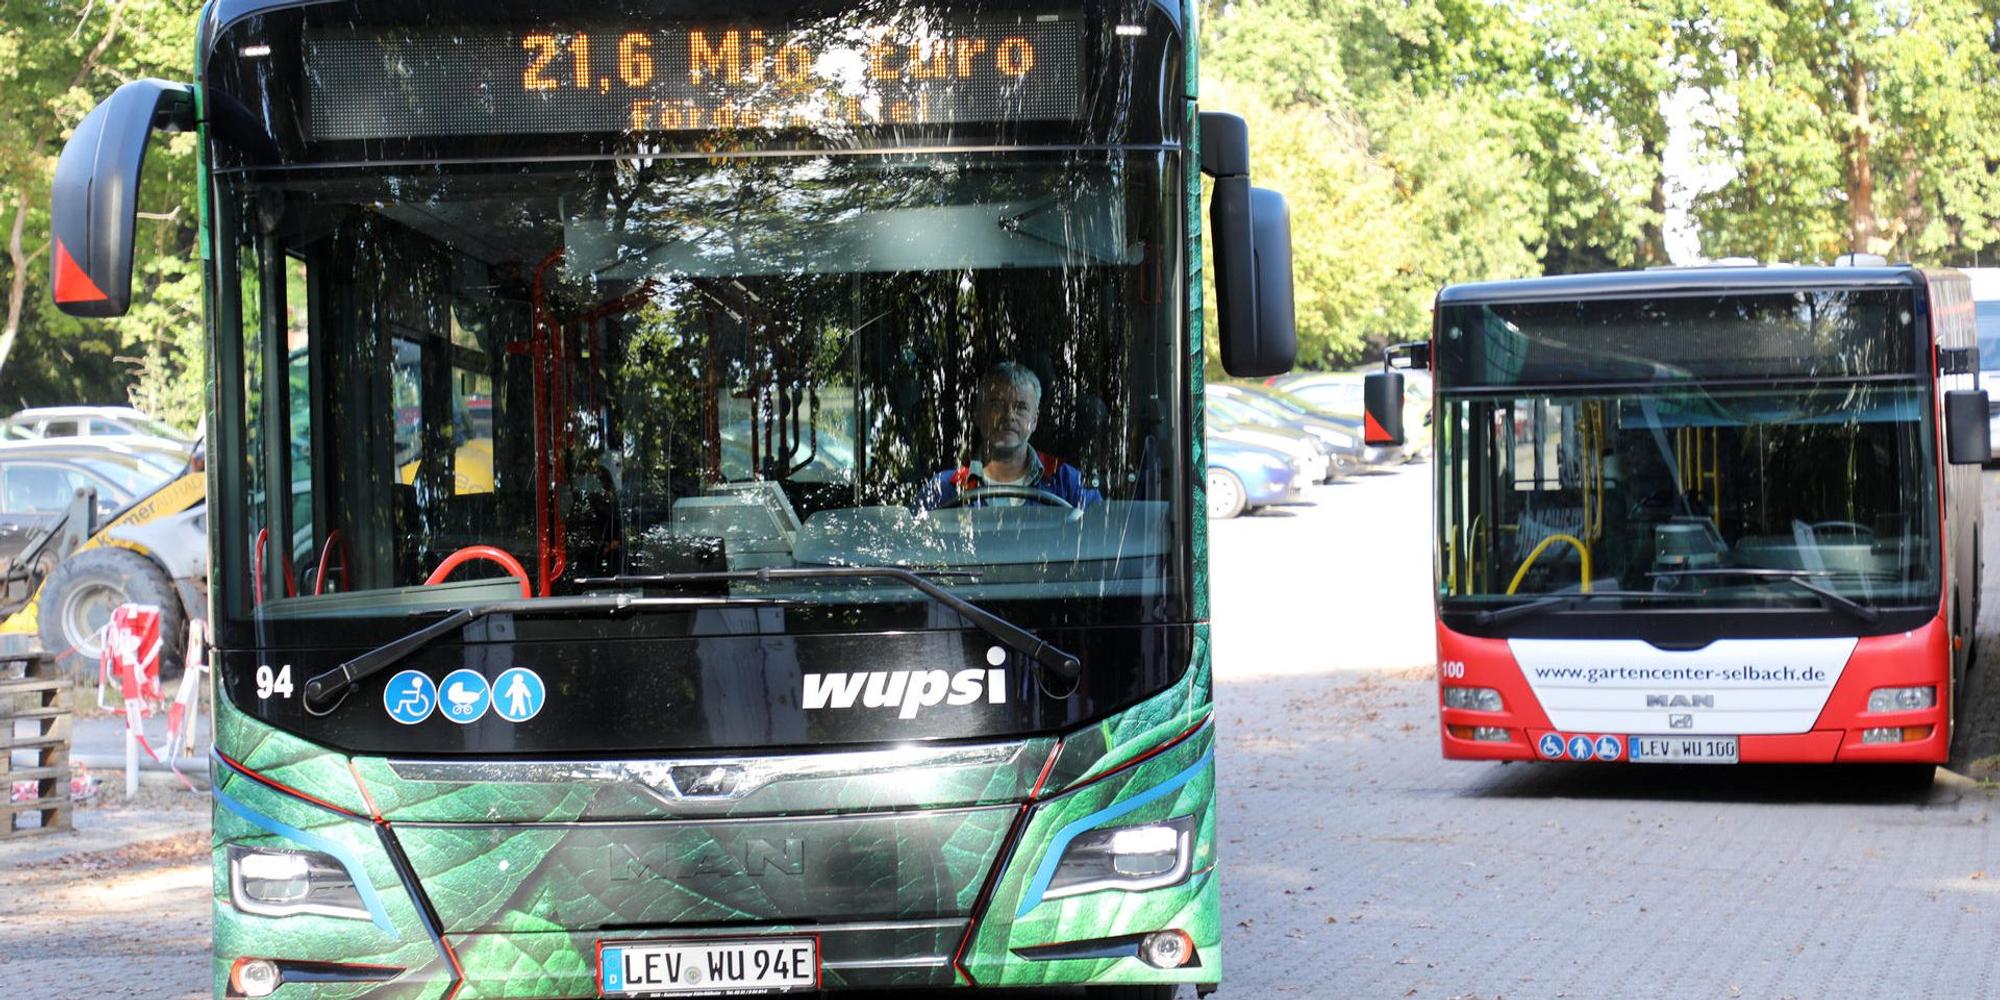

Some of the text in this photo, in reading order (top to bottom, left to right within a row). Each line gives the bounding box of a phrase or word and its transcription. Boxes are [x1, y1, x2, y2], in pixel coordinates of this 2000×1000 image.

[523, 33, 653, 95] 21,6
[866, 26, 1036, 81] Euro
[632, 93, 929, 130] Förderitel
[256, 664, 294, 699] 94
[802, 646, 1006, 719] wupsi
[1442, 660, 1465, 679] 100
[1535, 665, 1826, 682] www.gartencenter-selbach.de
[1646, 694, 1714, 708] MAN
[1640, 740, 1735, 757] LEV WU 100
[610, 838, 804, 881] MAN
[625, 948, 810, 984] LEV WU 94E
